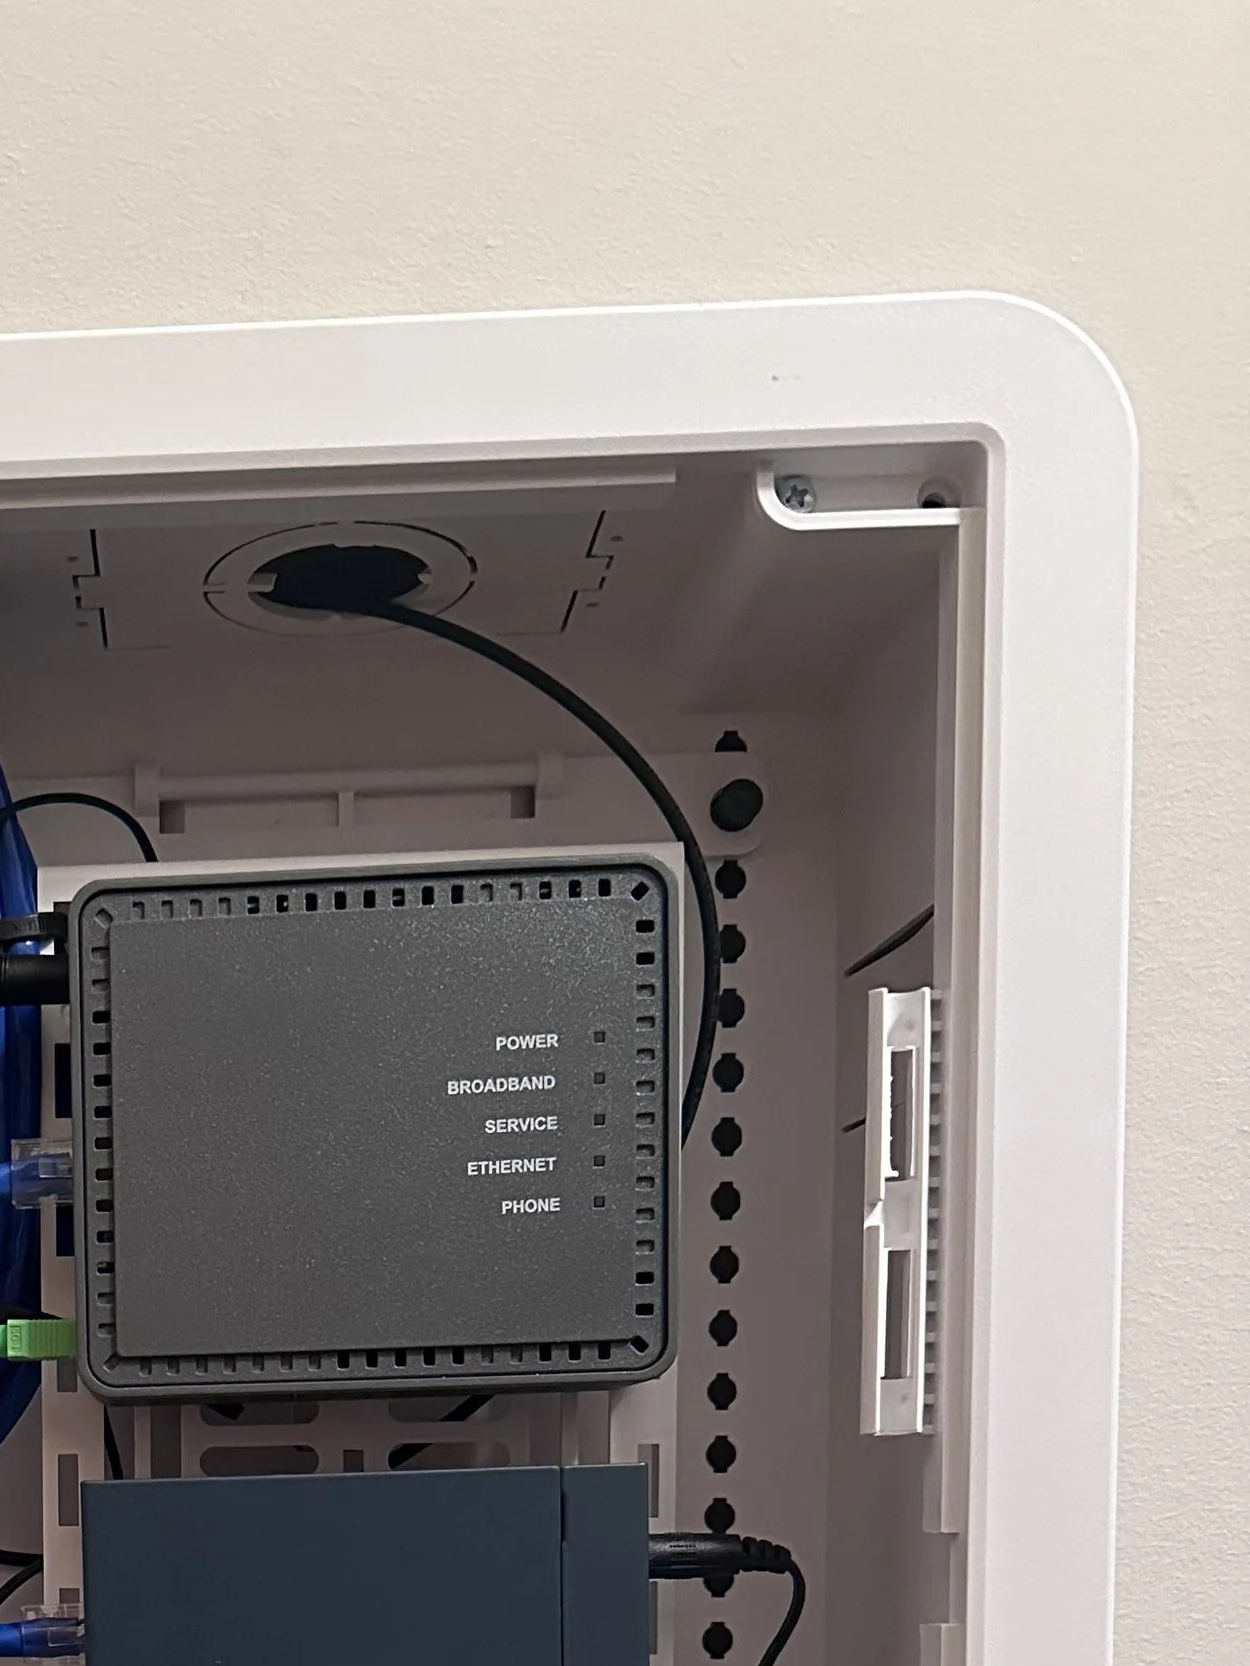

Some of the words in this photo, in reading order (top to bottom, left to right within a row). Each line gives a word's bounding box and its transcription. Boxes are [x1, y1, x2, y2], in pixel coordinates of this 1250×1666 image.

[496, 1034, 558, 1050] POWER
[447, 1075, 556, 1094] BROADBAND
[484, 1116, 558, 1134] SERVICE
[467, 1157, 556, 1175] ETHERNET
[501, 1198, 560, 1214] PHONE
